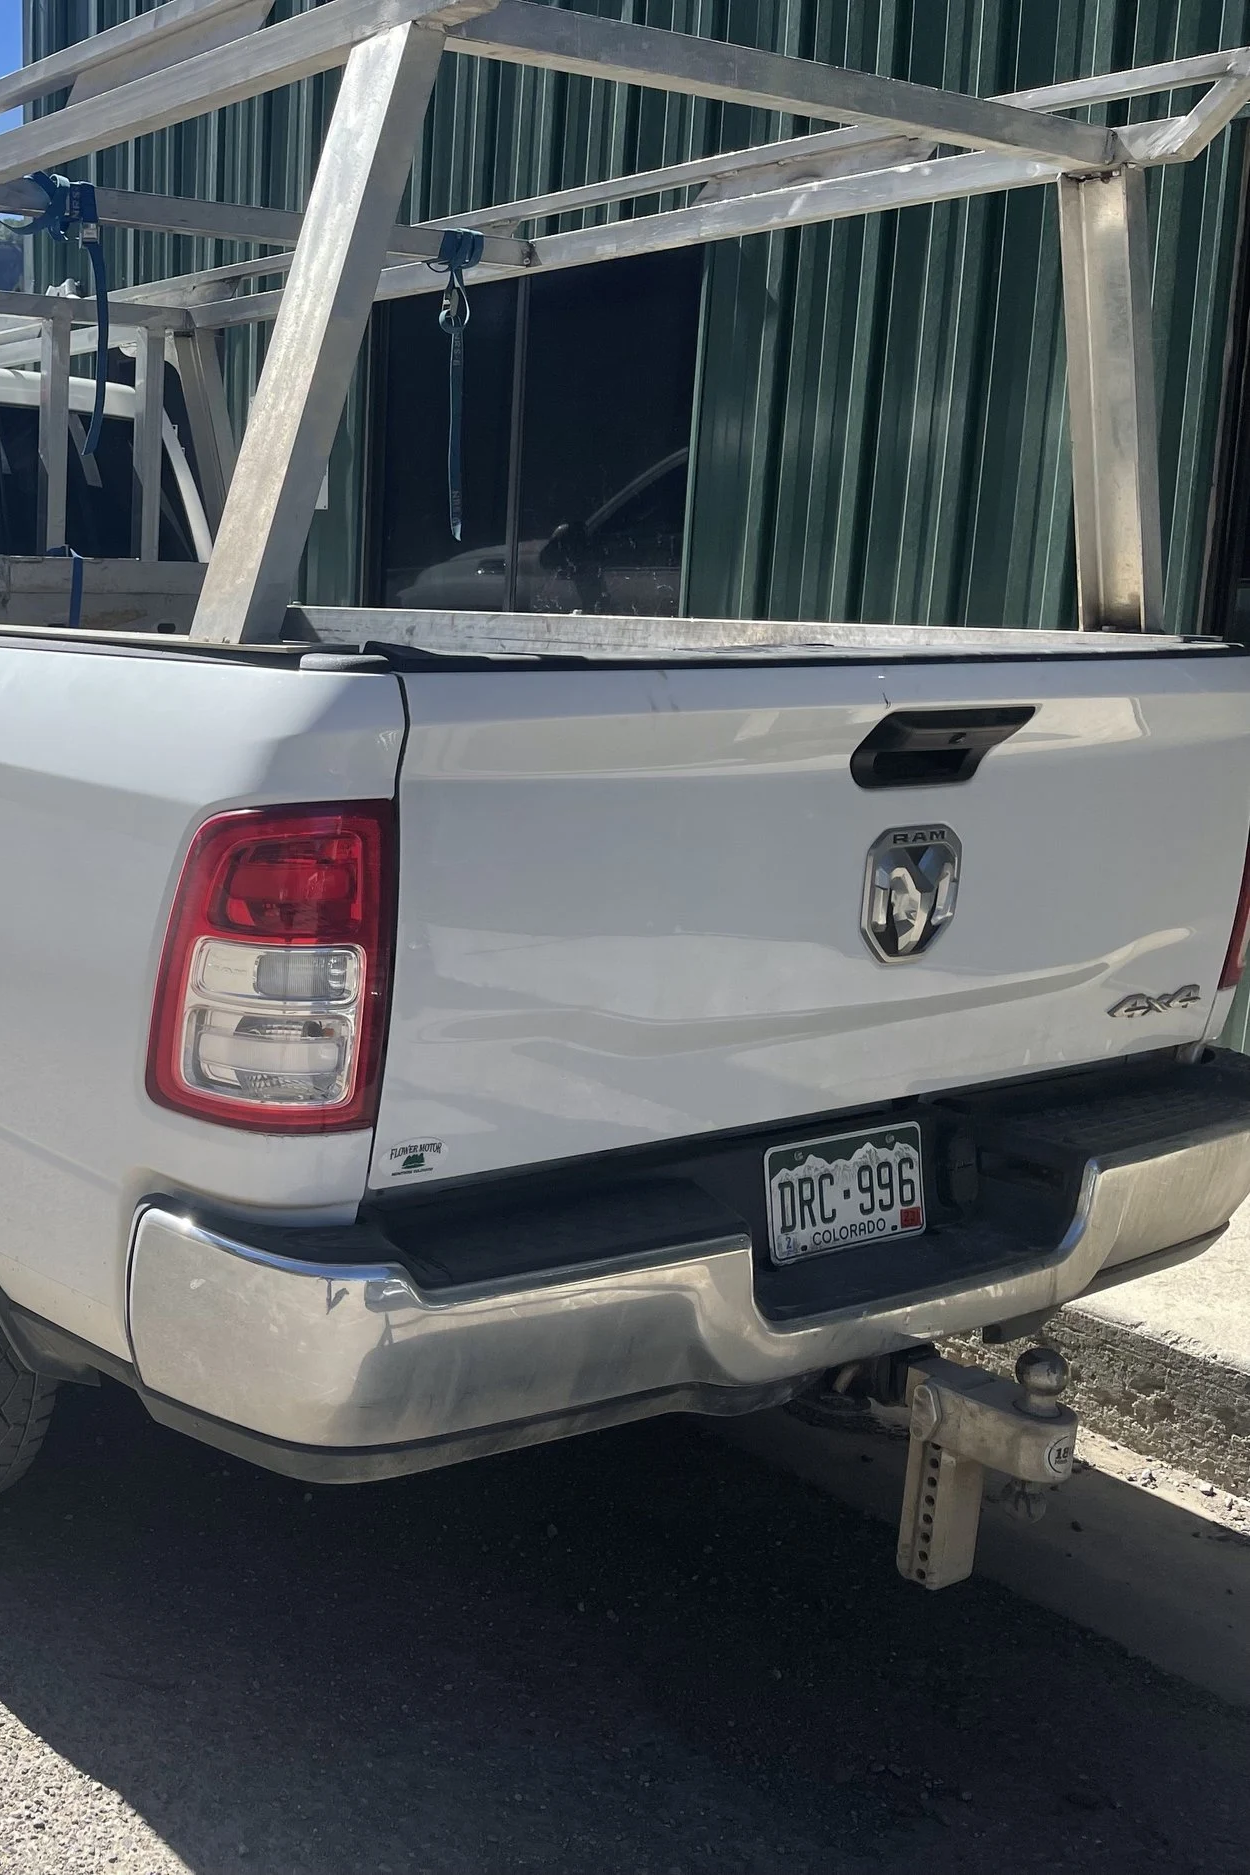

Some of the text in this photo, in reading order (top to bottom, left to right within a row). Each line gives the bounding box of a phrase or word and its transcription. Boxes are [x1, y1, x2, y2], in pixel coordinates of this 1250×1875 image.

[893, 830, 946, 844] RAM
[390, 1142, 443, 1160] FLOWER MOTOR
[812, 1217, 887, 1246] COLORADO
